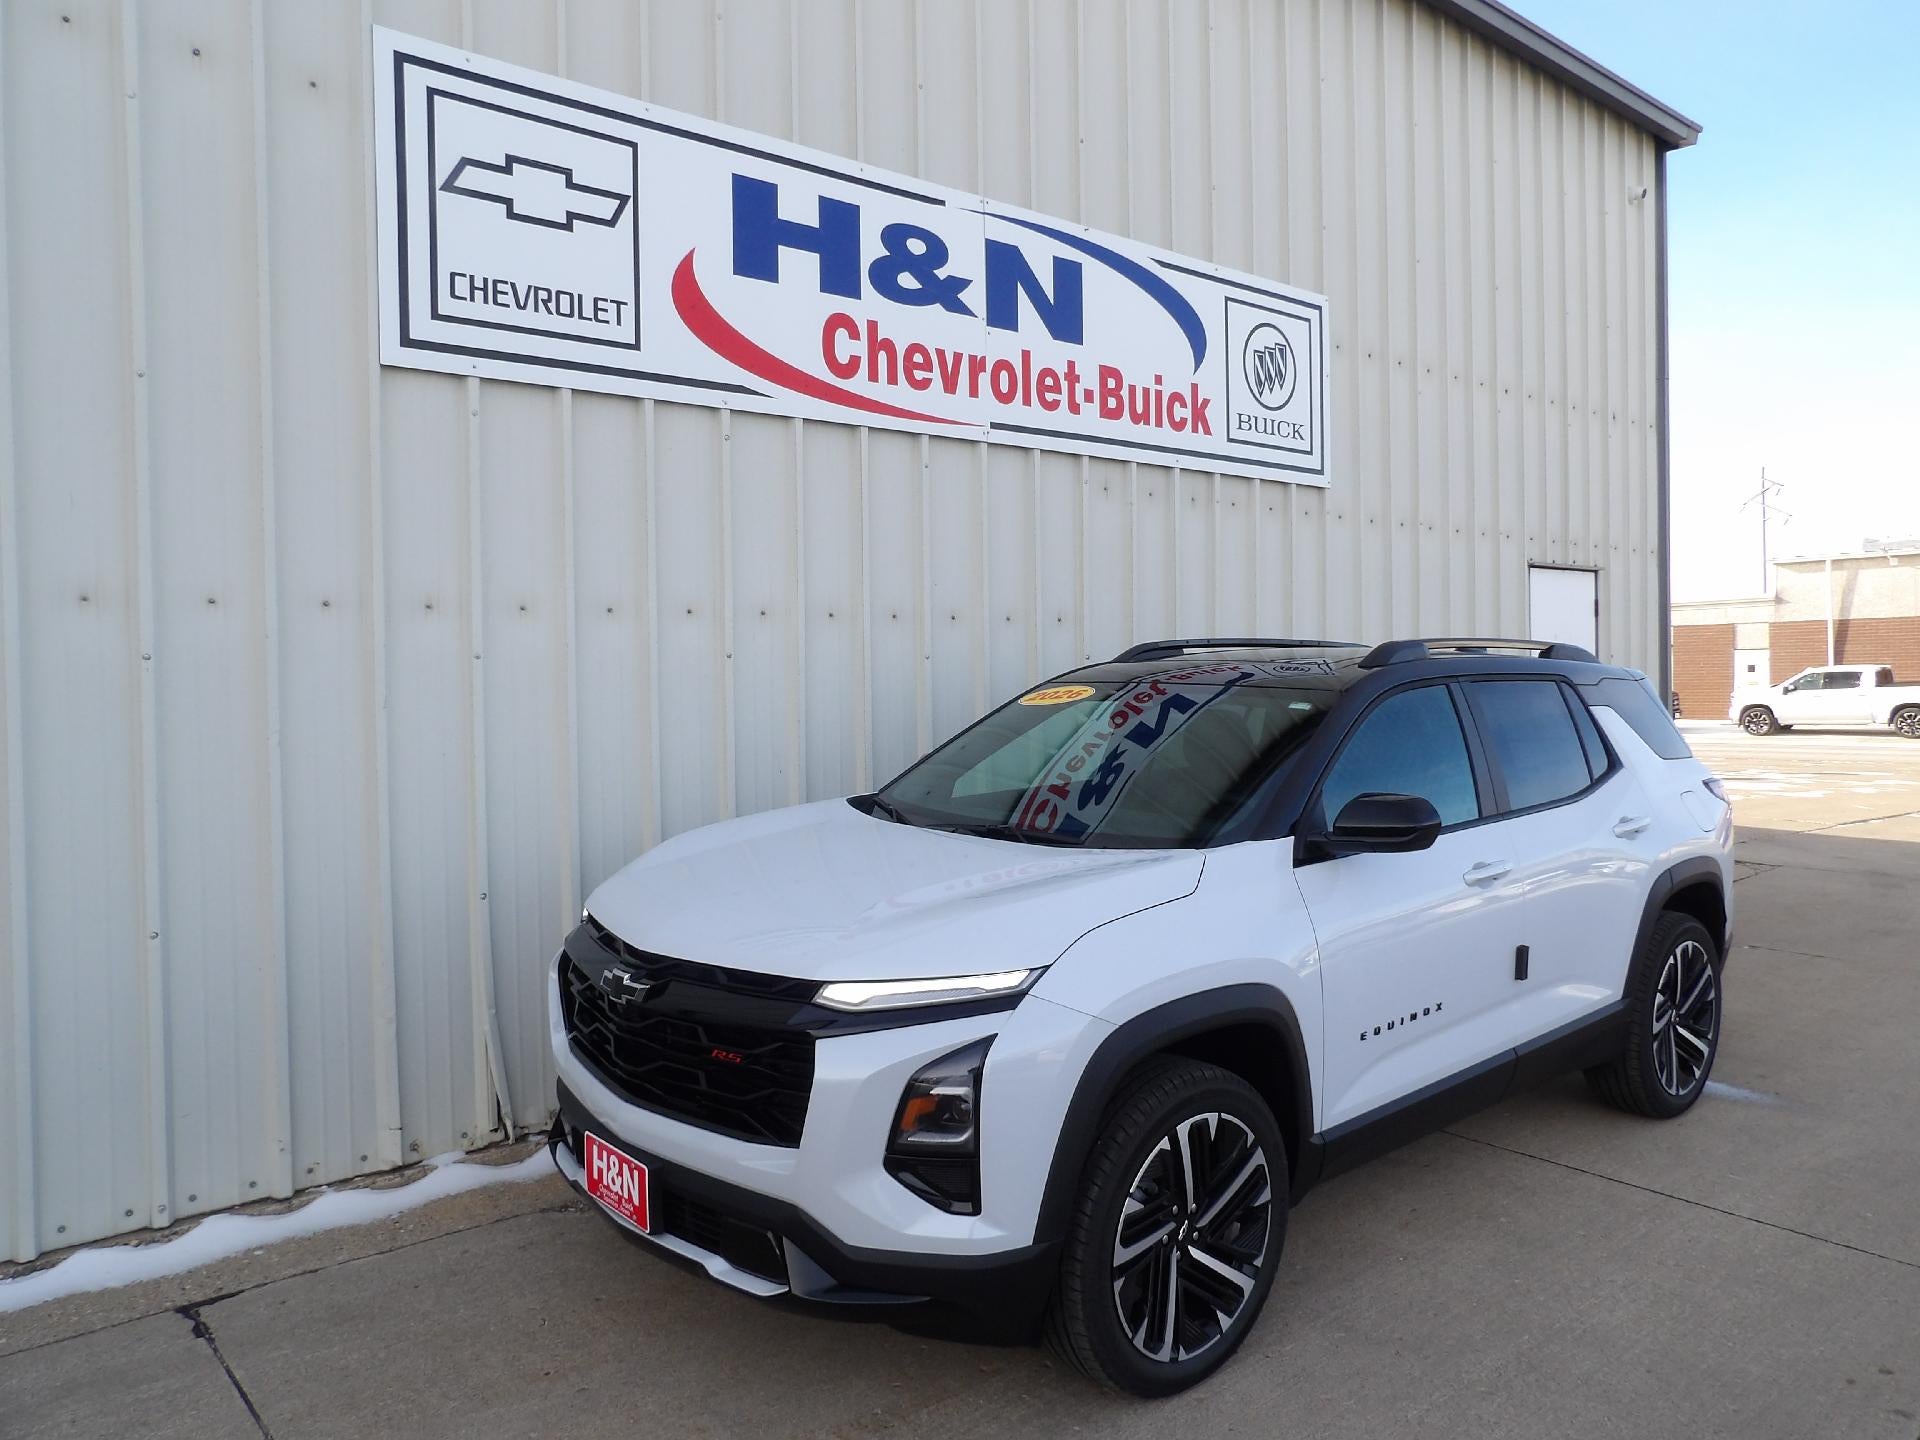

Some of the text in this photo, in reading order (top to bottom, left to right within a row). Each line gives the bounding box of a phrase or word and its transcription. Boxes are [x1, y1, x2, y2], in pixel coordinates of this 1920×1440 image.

[732, 173, 1084, 346] H&N
[449, 271, 628, 327] CHEVROLET
[822, 312, 1213, 436] Chevrolet-Buick
[1236, 412, 1305, 441] BUICK
[1360, 1002, 1442, 1041] EQUINOX
[711, 1049, 742, 1063] RS
[593, 1144, 639, 1206] H&N
